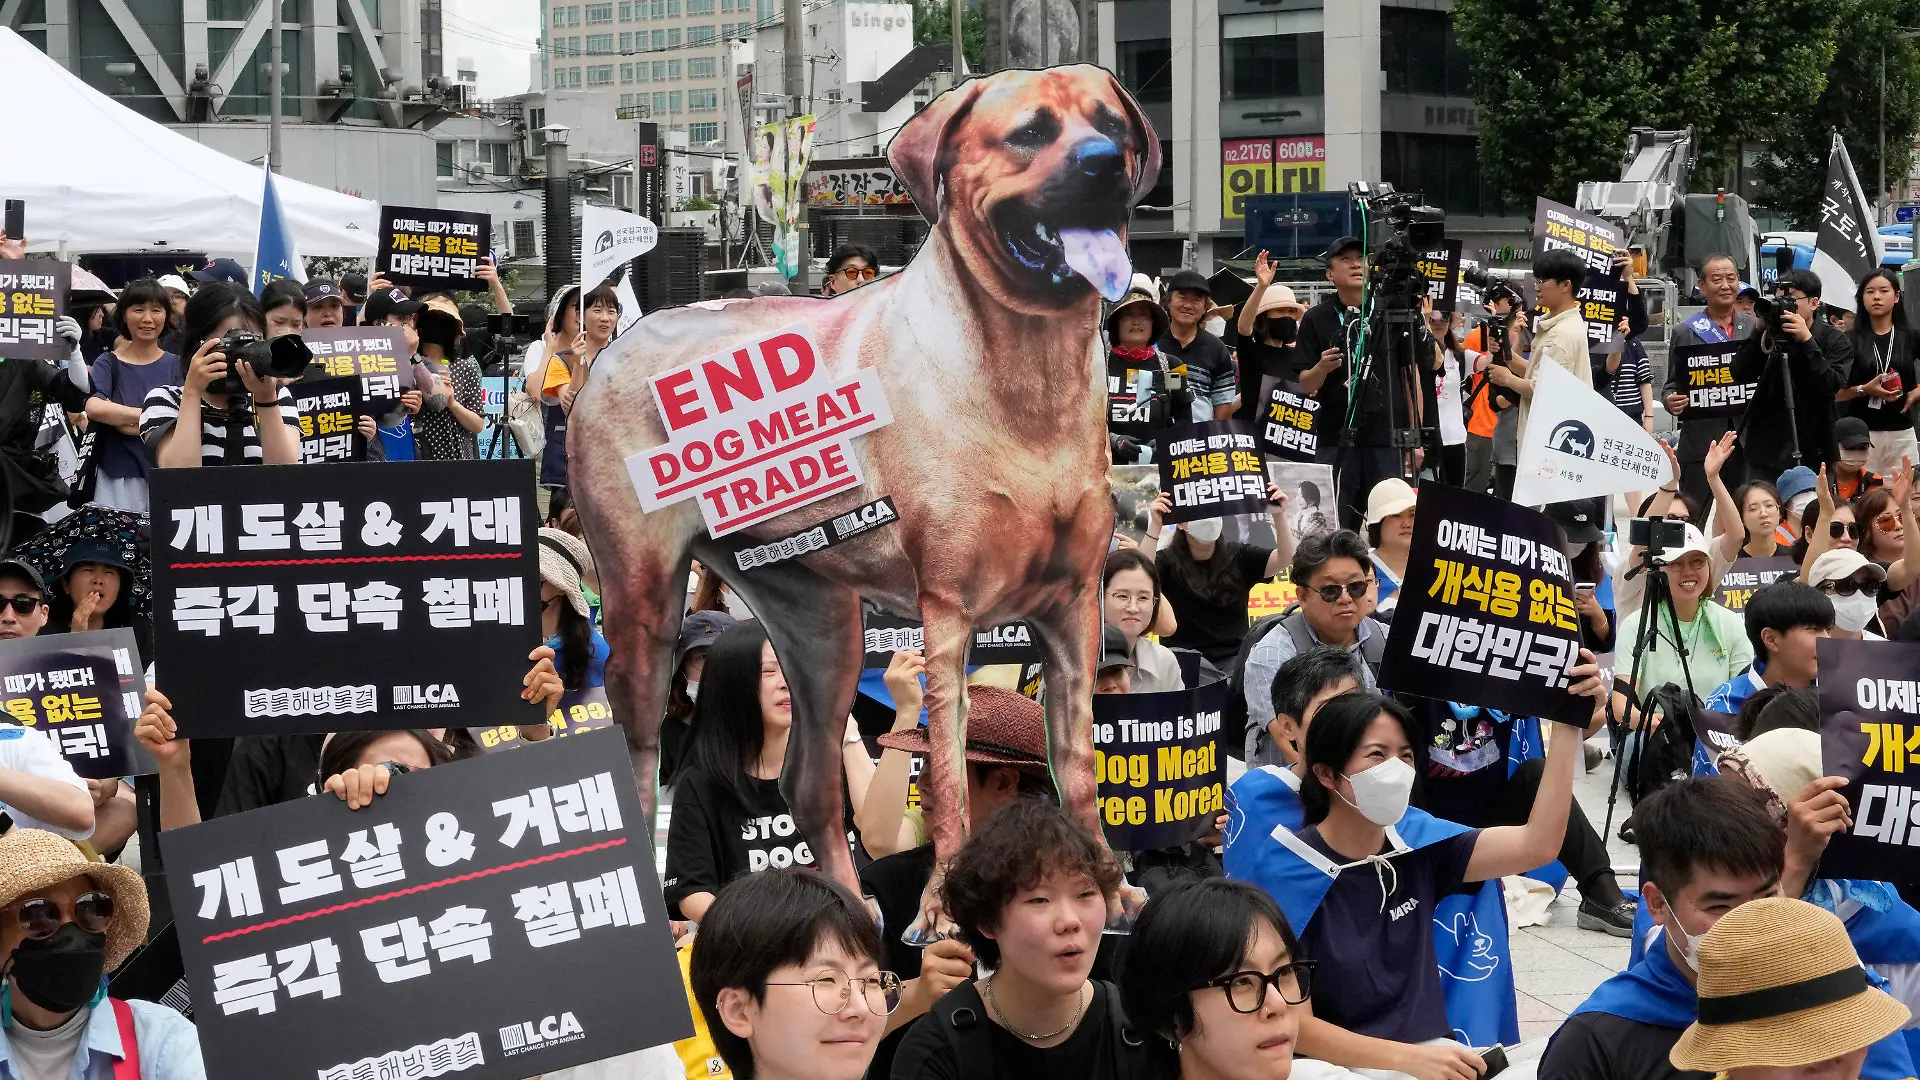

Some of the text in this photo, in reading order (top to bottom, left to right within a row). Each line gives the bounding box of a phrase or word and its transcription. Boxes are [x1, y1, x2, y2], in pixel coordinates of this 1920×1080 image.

[852, 11, 907, 31] bingo
[393, 218, 478, 236] 이제는 때가 됐다!
[1545, 221, 1615, 255] 개식용 없는
[391, 233, 478, 256] 개식용 없는
[390, 254, 477, 280] 대한민국!
[21, 274, 55, 290] 됐다!
[1592, 288, 1617, 303] 됐다!
[12, 292, 55, 316] 없는
[1585, 302, 1615, 322] 없는
[334, 339, 361, 353] 때가
[362, 338, 393, 352] 됐다!
[1586, 320, 1613, 343] 국!
[357, 354, 397, 374] 없는
[1687, 352, 1737, 368] 이제는 때
[654, 332, 816, 431] END
[1688, 366, 1734, 386] 개식용
[323, 391, 351, 408] 됐다!
[1272, 389, 1303, 408] 이제는
[317, 411, 353, 435] 없는
[1269, 403, 1313, 431] 개식용
[648, 381, 863, 487] DOG MEAT
[1169, 438, 1206, 457] 이제는
[1207, 434, 1234, 449] 때가
[1264, 421, 1317, 455] 대한민
[1171, 450, 1262, 479] 개식용 없는
[1602, 437, 1661, 466] 전국길고양이
[1598, 452, 1659, 480] 보호단체연합
[703, 443, 850, 519] TRADE
[1173, 474, 1267, 507] 대한민국!
[170, 496, 523, 555] 개 도살 & 거래
[849, 500, 894, 530] LCA
[1437, 519, 1570, 582] 이제는 때가 됐다!
[172, 576, 525, 637] 즉각 단속 철폐
[1427, 558, 1578, 632] 개식용 없는
[992, 625, 1031, 643] LCA
[1410, 611, 1579, 689] 대한민국!
[4, 666, 96, 694] 때가 됐다!
[412, 683, 460, 704] LCA
[41, 693, 103, 724] 없는
[249, 687, 374, 714] 동물해방물결
[1856, 678, 1920, 714] 이제
[1118, 719, 1174, 743] Time
[1177, 715, 1193, 740] is
[1196, 710, 1221, 736] Now
[1094, 740, 1217, 788] Dog Meat
[1154, 782, 1223, 824] Korea
[192, 771, 624, 921] 개 도살 & 거래
[748, 842, 816, 873] DOG
[213, 865, 647, 1017] 즉각 단속 철폐
[523, 1011, 584, 1045] LCA
[503, 1032, 586, 1057] LAST CHANCE FOR ANIMALS
